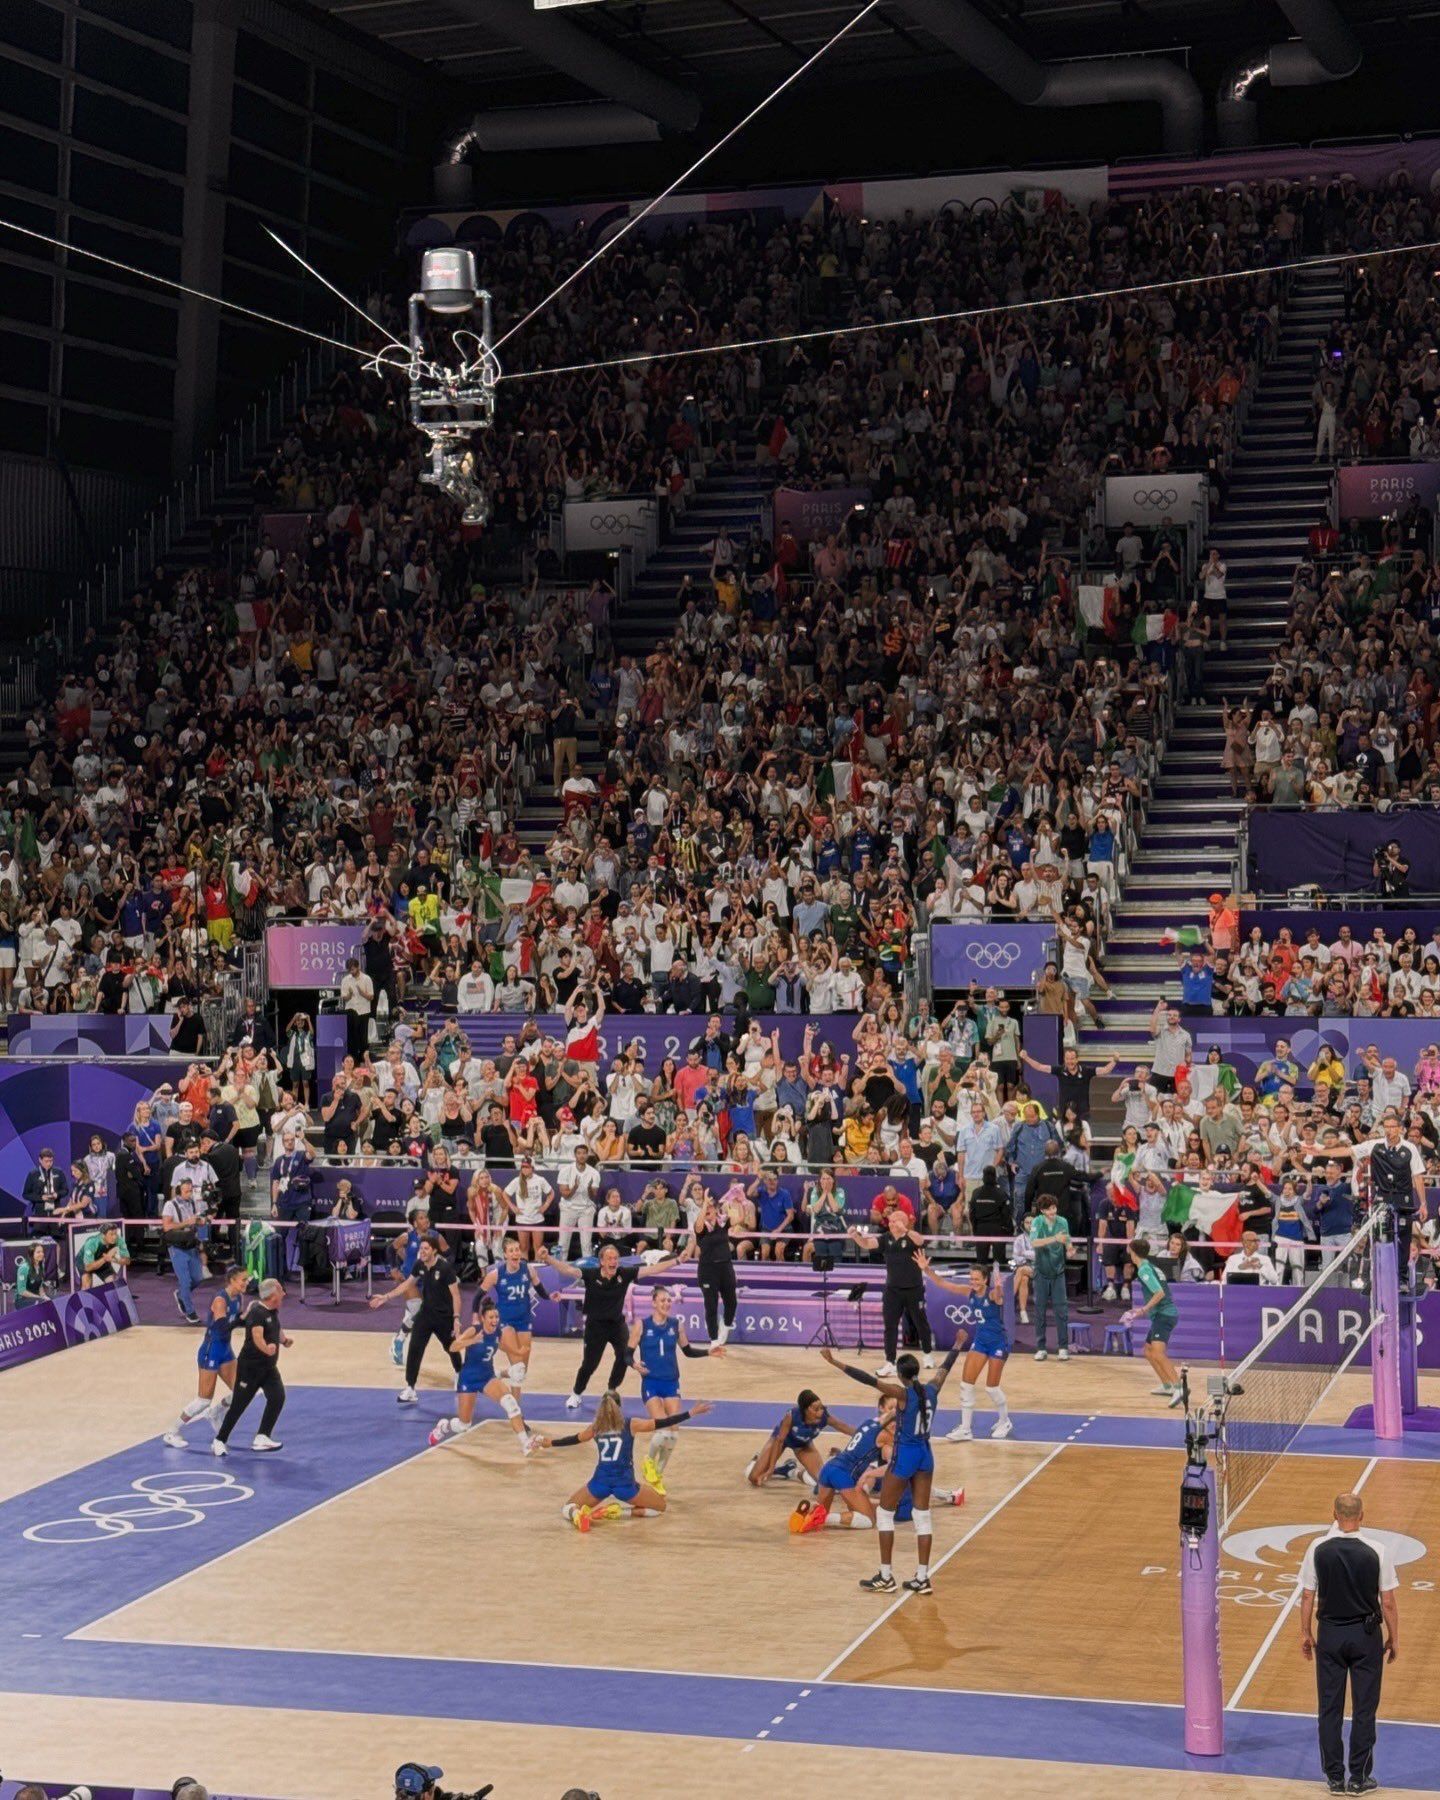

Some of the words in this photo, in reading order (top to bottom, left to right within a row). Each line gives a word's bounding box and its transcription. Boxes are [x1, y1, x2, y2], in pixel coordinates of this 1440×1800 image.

[1370, 477, 1415, 490] PARIS
[802, 503, 842, 515] PARIS
[300, 942, 346, 956] PARIS
[300, 957, 347, 971] 2024
[507, 1284, 526, 1301] 24
[745, 1316, 803, 1332] 2024
[974, 1309, 986, 1324] 9
[25, 1320, 57, 1342] 2024
[482, 1346, 495, 1362] 3
[659, 1338, 665, 1357] 1
[847, 1431, 863, 1451] 8
[598, 1437, 623, 1462] 27
